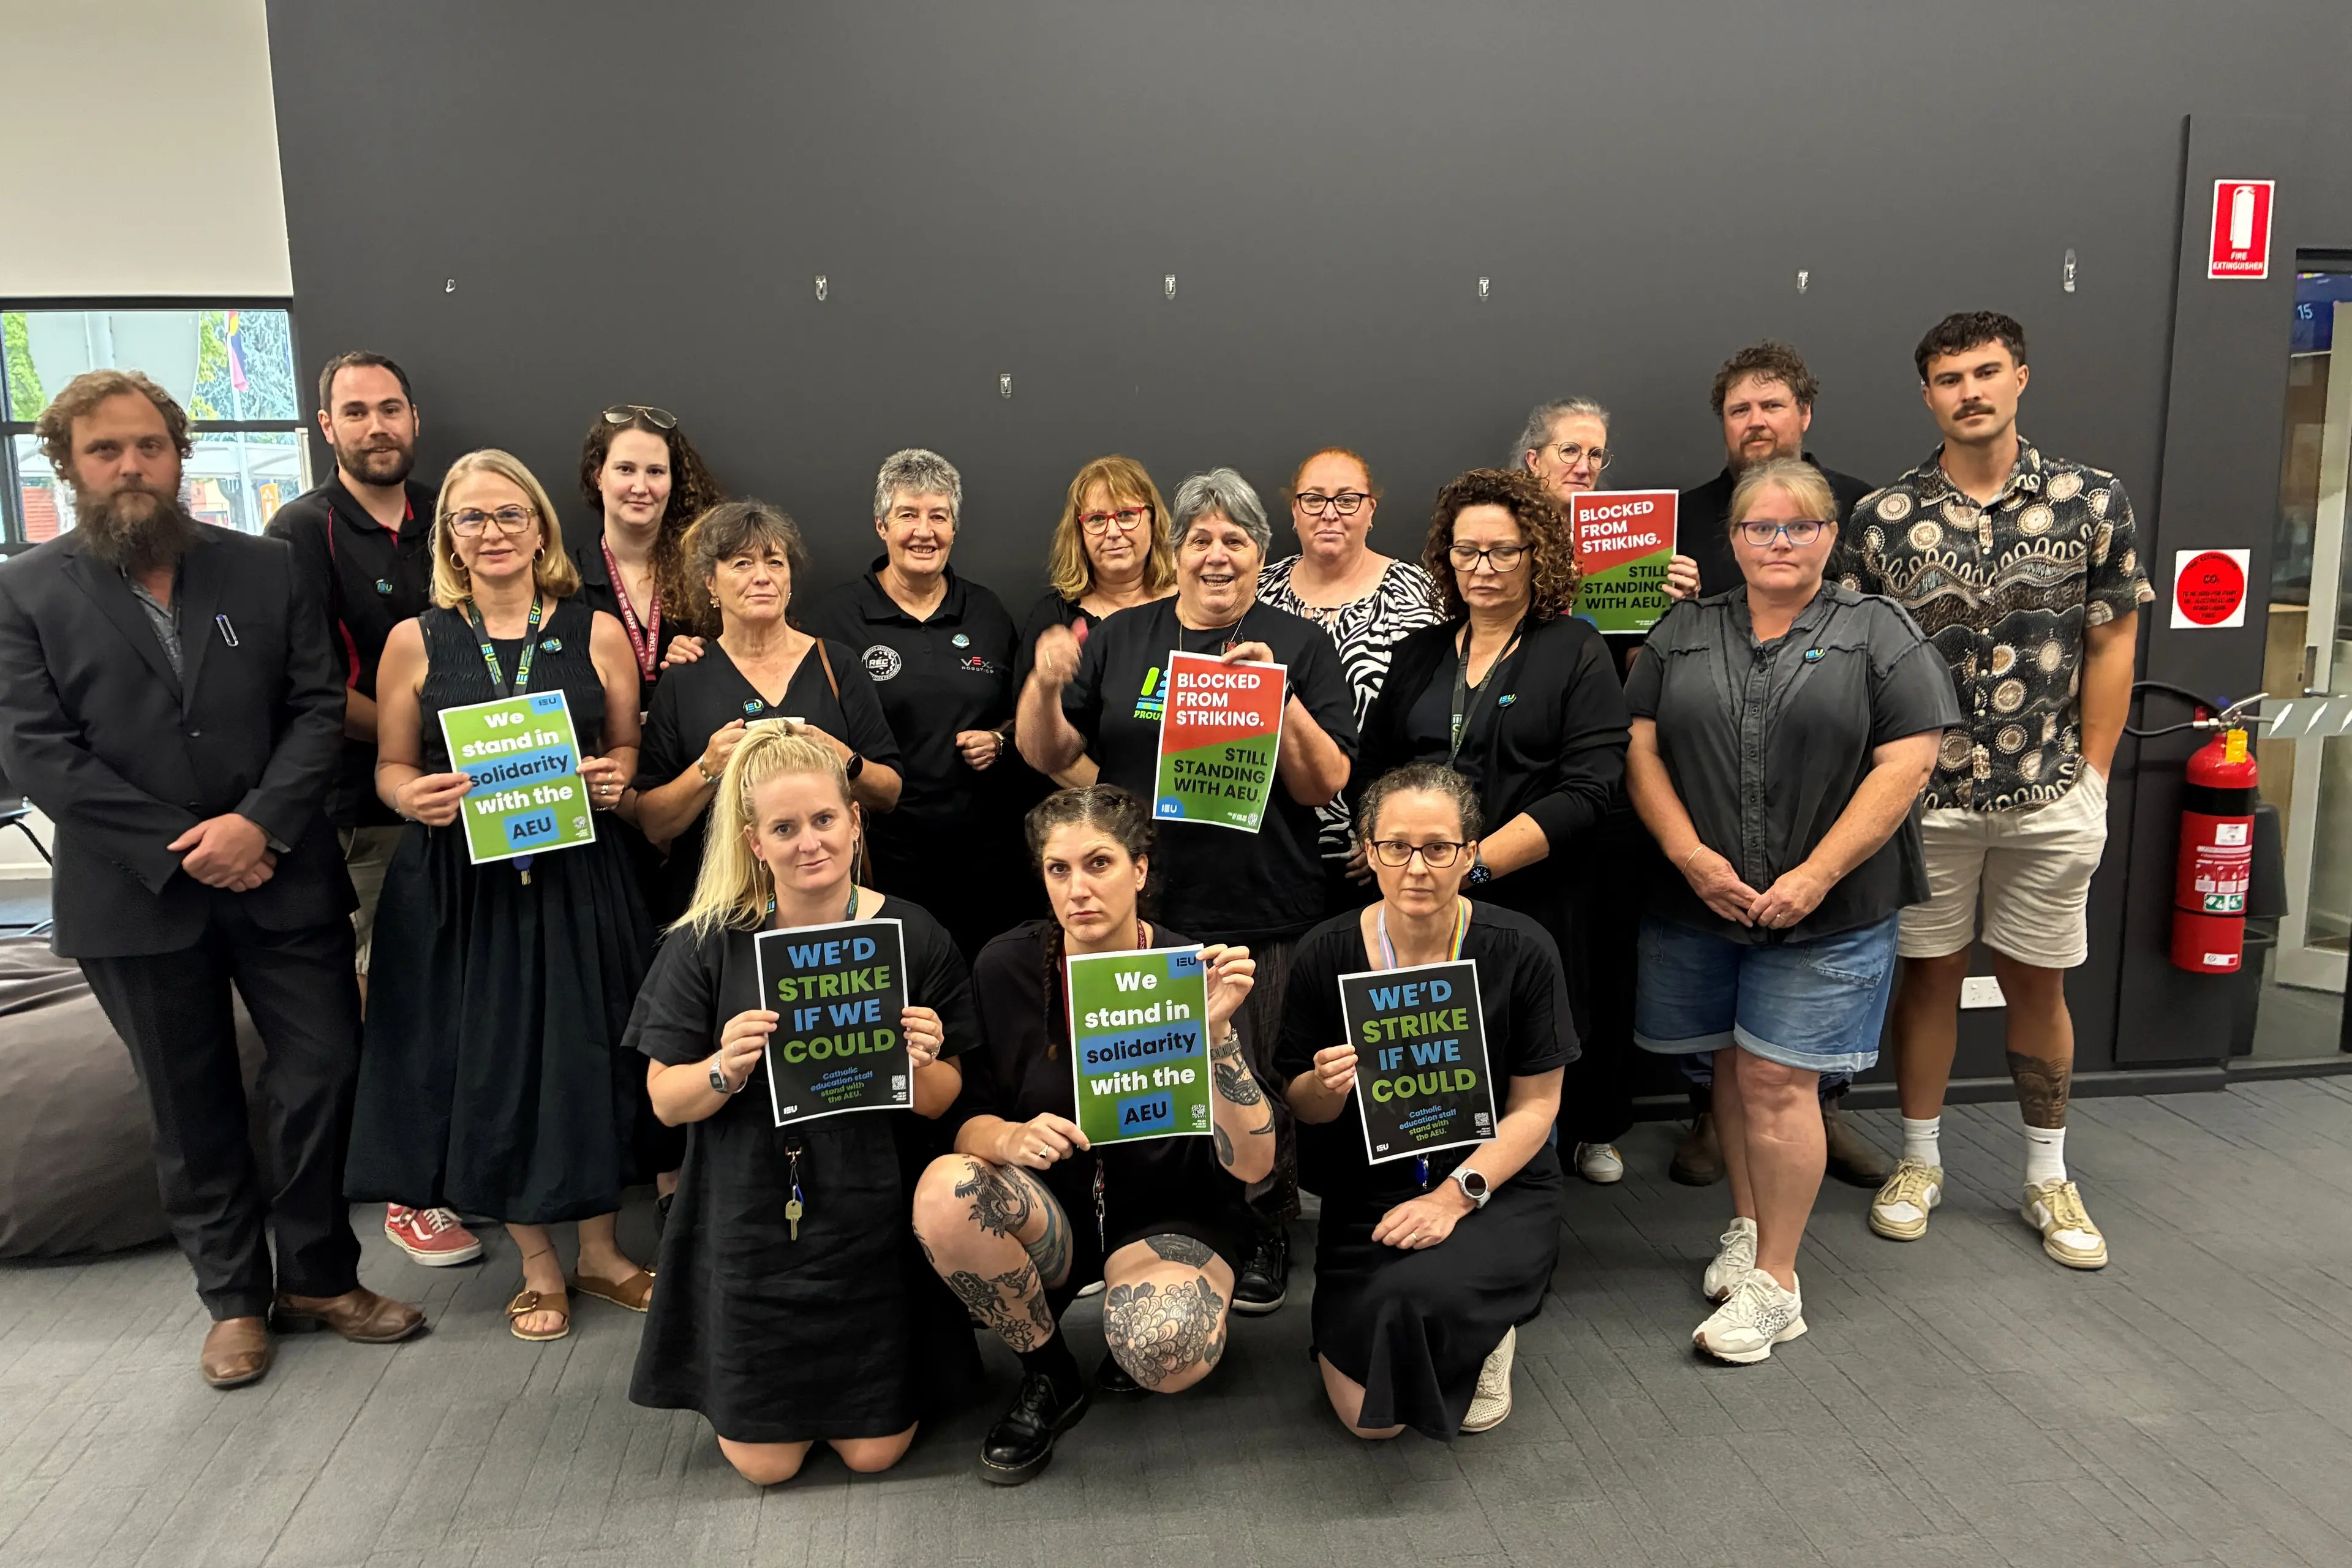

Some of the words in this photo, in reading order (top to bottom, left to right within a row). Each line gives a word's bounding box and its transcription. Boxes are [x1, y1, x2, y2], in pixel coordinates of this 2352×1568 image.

[2231, 251, 2248, 261] FIRE
[2213, 261, 2264, 271] EXTINGUISHER
[2297, 303, 2313, 320] 15
[1579, 500, 1654, 522] BLOCKED
[1581, 520, 1627, 538] FROM
[1582, 532, 1662, 554] STRIKING.
[1629, 565, 1667, 578] STILL
[1586, 597, 1627, 609] WITH
[1630, 597, 1666, 609] AEU.
[542, 638, 560, 650] IEU
[1805, 649, 1824, 657] IEU
[1177, 673, 1261, 689] BLOCKED
[538, 698, 557, 706] IEU
[1177, 692, 1229, 707] FROM
[1499, 693, 1515, 703] IEU
[745, 703, 762, 712] IEU
[1134, 710, 1162, 720] PROU
[484, 712, 524, 728] We
[1176, 710, 1265, 727] STRIKING.
[462, 732, 533, 757] stand
[534, 728, 560, 746] in
[1225, 747, 1268, 766] STILL
[470, 755, 568, 788] solidarity
[1174, 760, 1265, 784] STANDING
[1174, 777, 1219, 796] WITH
[1224, 785, 1261, 803] AEU.
[475, 792, 530, 815] with
[533, 785, 573, 805] the
[1161, 804, 1177, 813] IEU
[513, 817, 552, 840] AEU
[1177, 956, 1197, 967] IEU
[778, 965, 891, 1001] STRIKE
[1114, 971, 1158, 992] We
[794, 1006, 821, 1032] IF
[828, 998, 881, 1027] WE
[1085, 1002, 1160, 1028] stand
[1166, 999, 1190, 1020] in
[1362, 1008, 1469, 1043] STRIKE
[783, 1028, 895, 1063] COULD
[1087, 1032, 1197, 1064] solidarity
[1378, 1046, 1403, 1071] IF
[1410, 1039, 1461, 1065] WE
[810, 1076, 853, 1092] education
[854, 1071, 873, 1082] staff
[823, 1067, 858, 1080] Catholic
[1090, 1072, 1148, 1096] with
[1153, 1066, 1196, 1085] the
[821, 1085, 845, 1098] stand
[846, 1082, 865, 1093] with
[1372, 1068, 1476, 1102] COULD
[827, 1095, 842, 1104] the
[843, 1091, 862, 1101] AEU.
[783, 1105, 797, 1115] IEU
[1125, 1101, 1167, 1125] AEU
[1409, 1104, 1442, 1118] Catholic
[1399, 1114, 1438, 1130] education
[1438, 1108, 1457, 1120] staff
[1409, 1123, 1431, 1135] stand
[1431, 1118, 1449, 1130] with
[1415, 1132, 1429, 1141] the
[1430, 1128, 1447, 1138] AEU.
[1376, 1143, 1389, 1152] IEU
